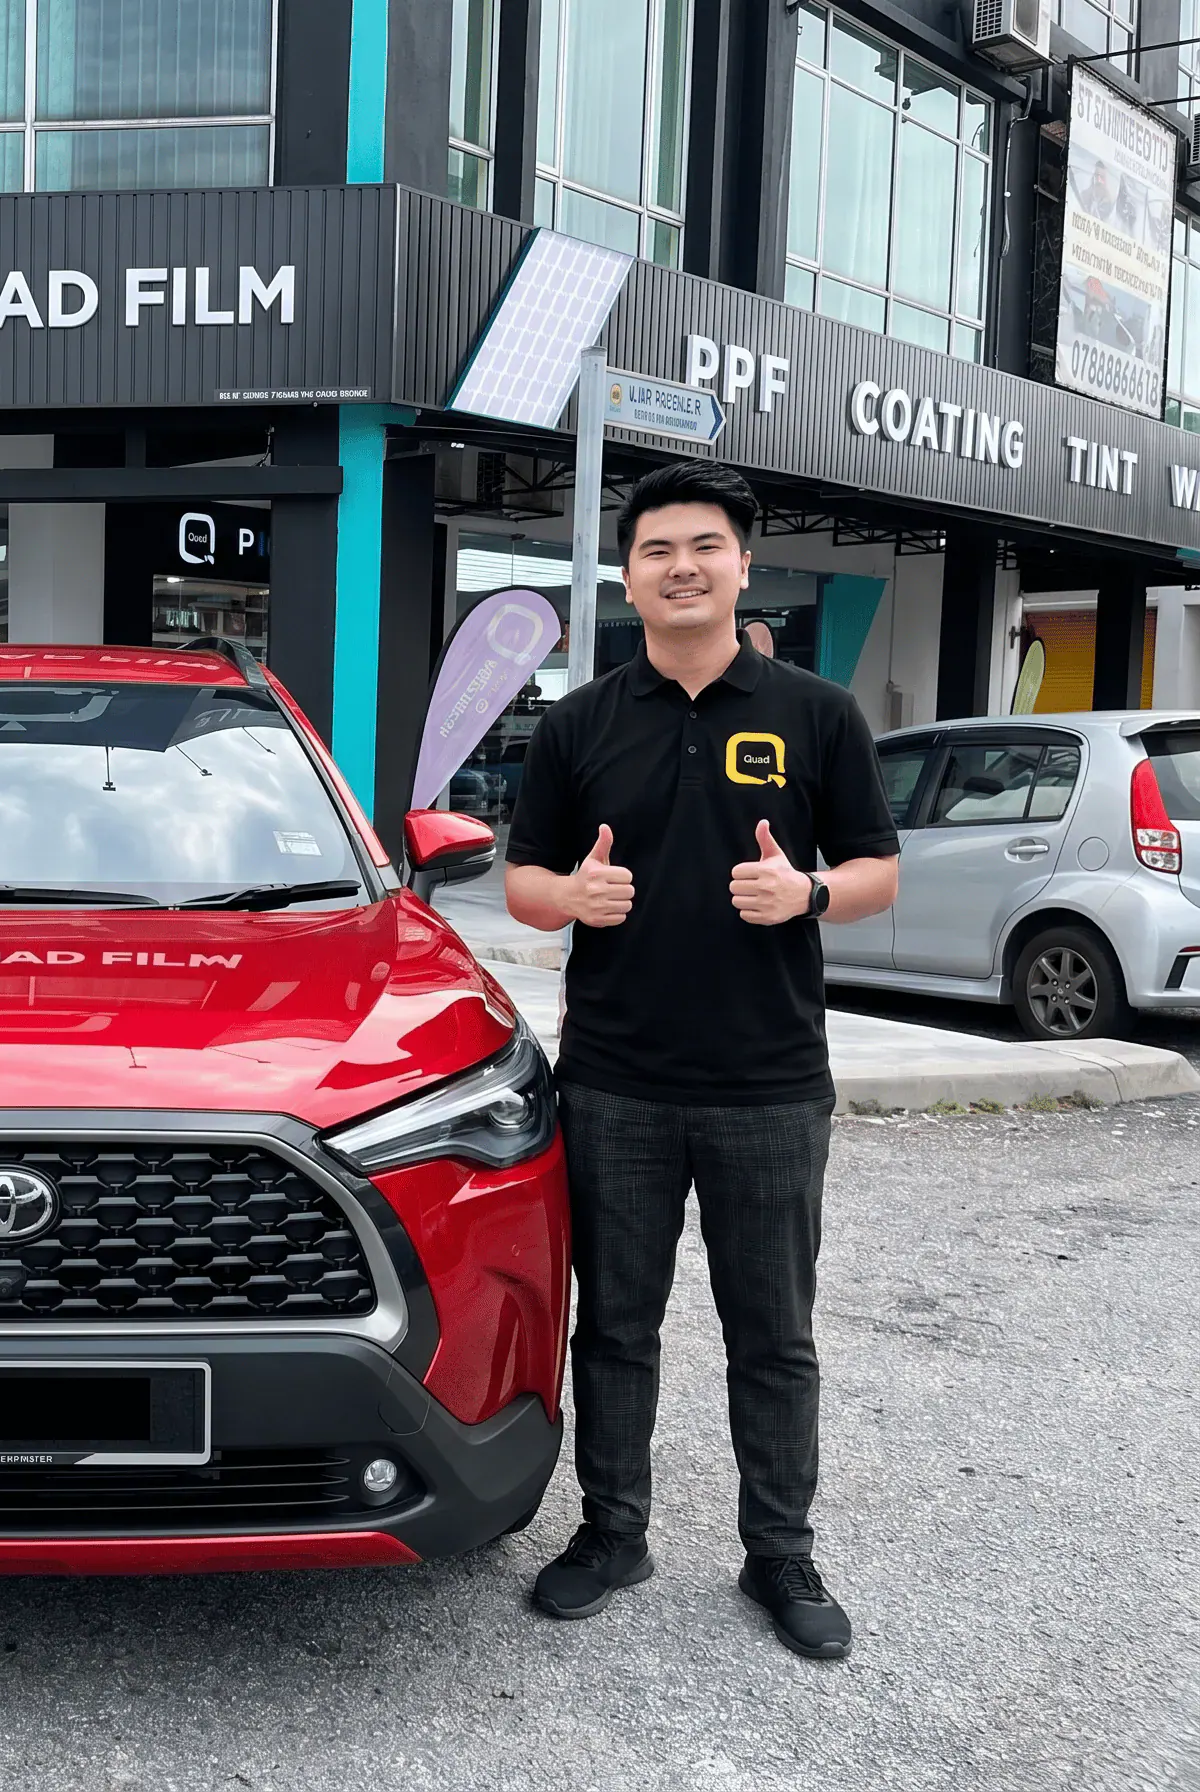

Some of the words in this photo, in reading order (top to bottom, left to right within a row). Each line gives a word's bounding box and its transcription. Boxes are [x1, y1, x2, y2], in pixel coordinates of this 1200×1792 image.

[125, 265, 296, 328] FILM
[686, 334, 791, 413] PPF
[850, 380, 1024, 469] COATING
[1067, 436, 1138, 495] TINT
[1171, 464, 1200, 512] W
